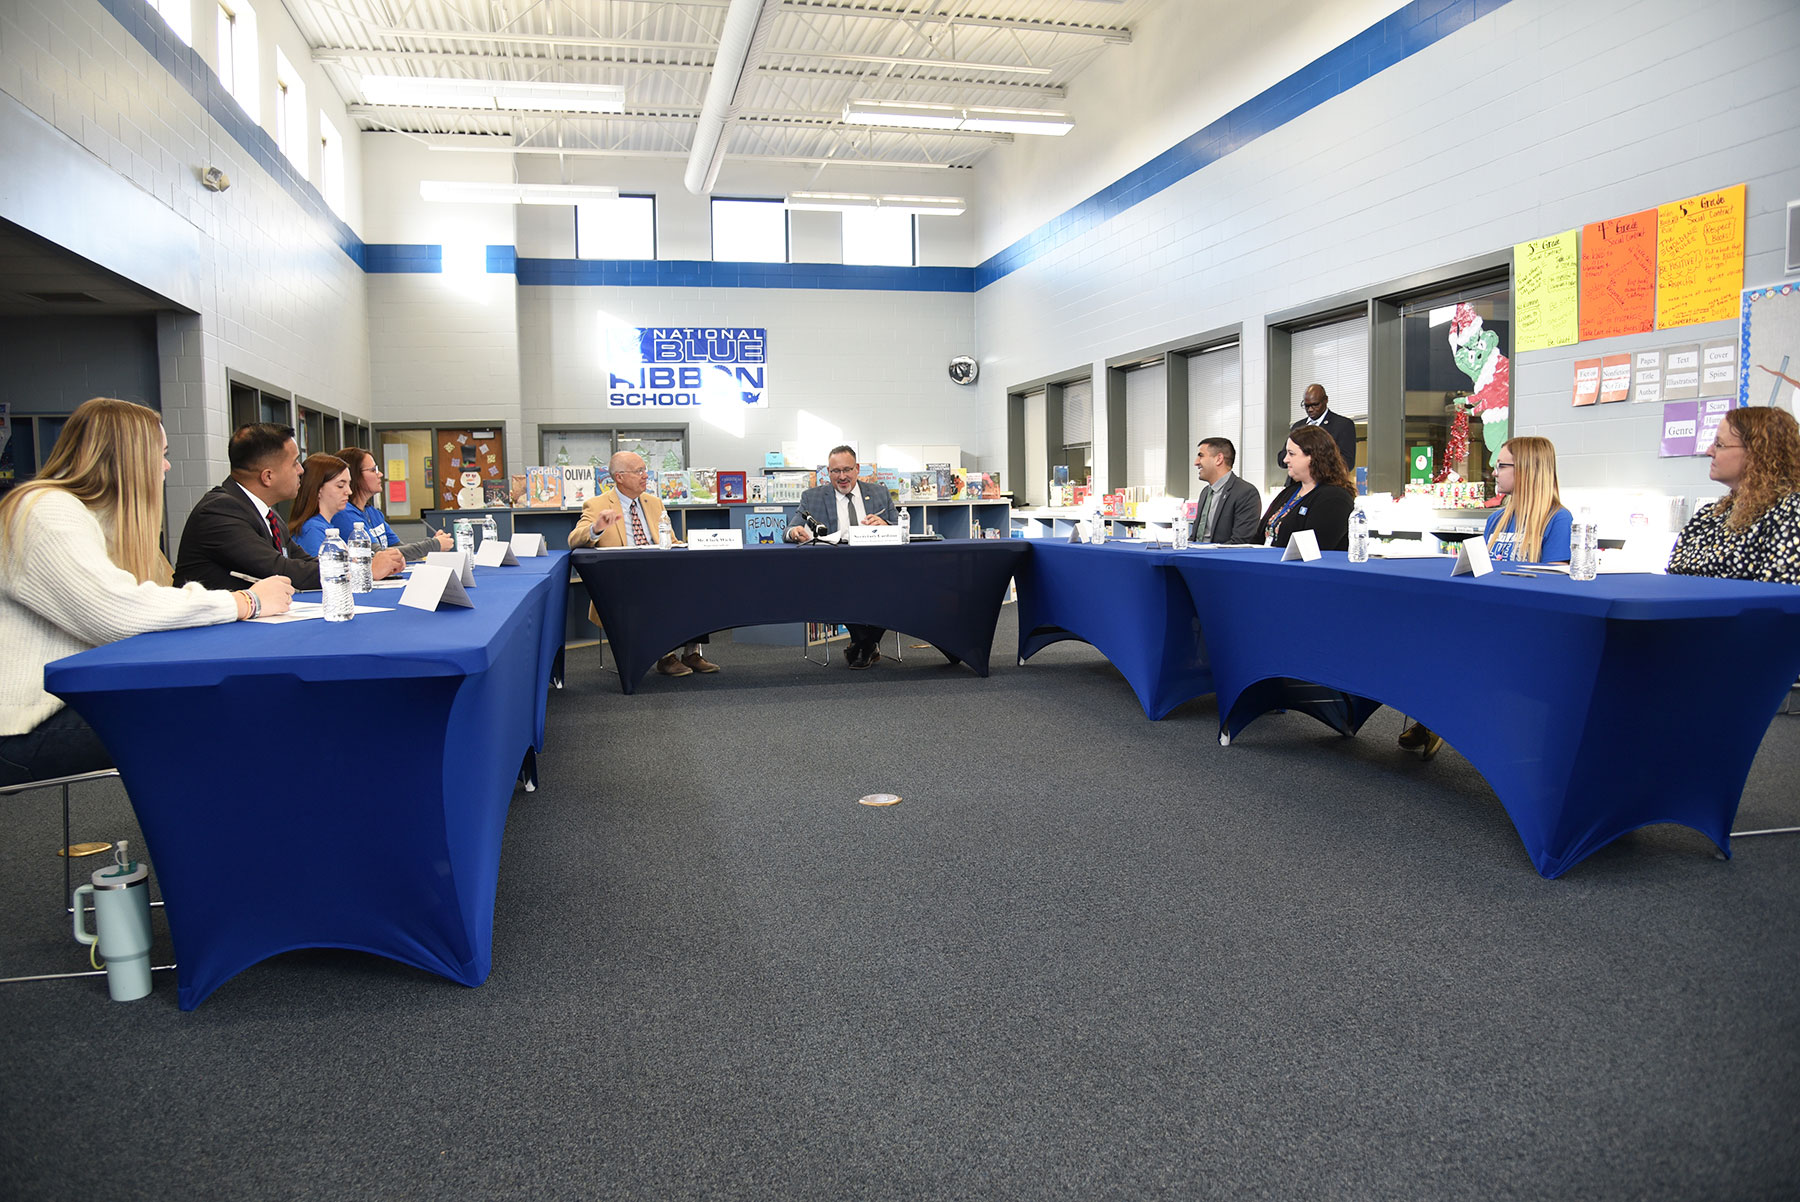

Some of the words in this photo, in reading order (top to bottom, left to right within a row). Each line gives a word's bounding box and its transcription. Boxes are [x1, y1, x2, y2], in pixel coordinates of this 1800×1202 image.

[654, 329, 763, 340] NATIONAL
[654, 339, 764, 363] BLUE
[1640, 358, 1657, 366] Pages
[1677, 356, 1690, 364] Text
[610, 367, 764, 389] IBBN
[1709, 370, 1727, 379] Spine
[1666, 377, 1697, 386] Illustration
[1709, 403, 1726, 412] Scary
[1668, 426, 1693, 436] Genre
[530, 466, 559, 477] oddly
[565, 469, 592, 481] OLIVIA
[748, 516, 786, 531] READING
